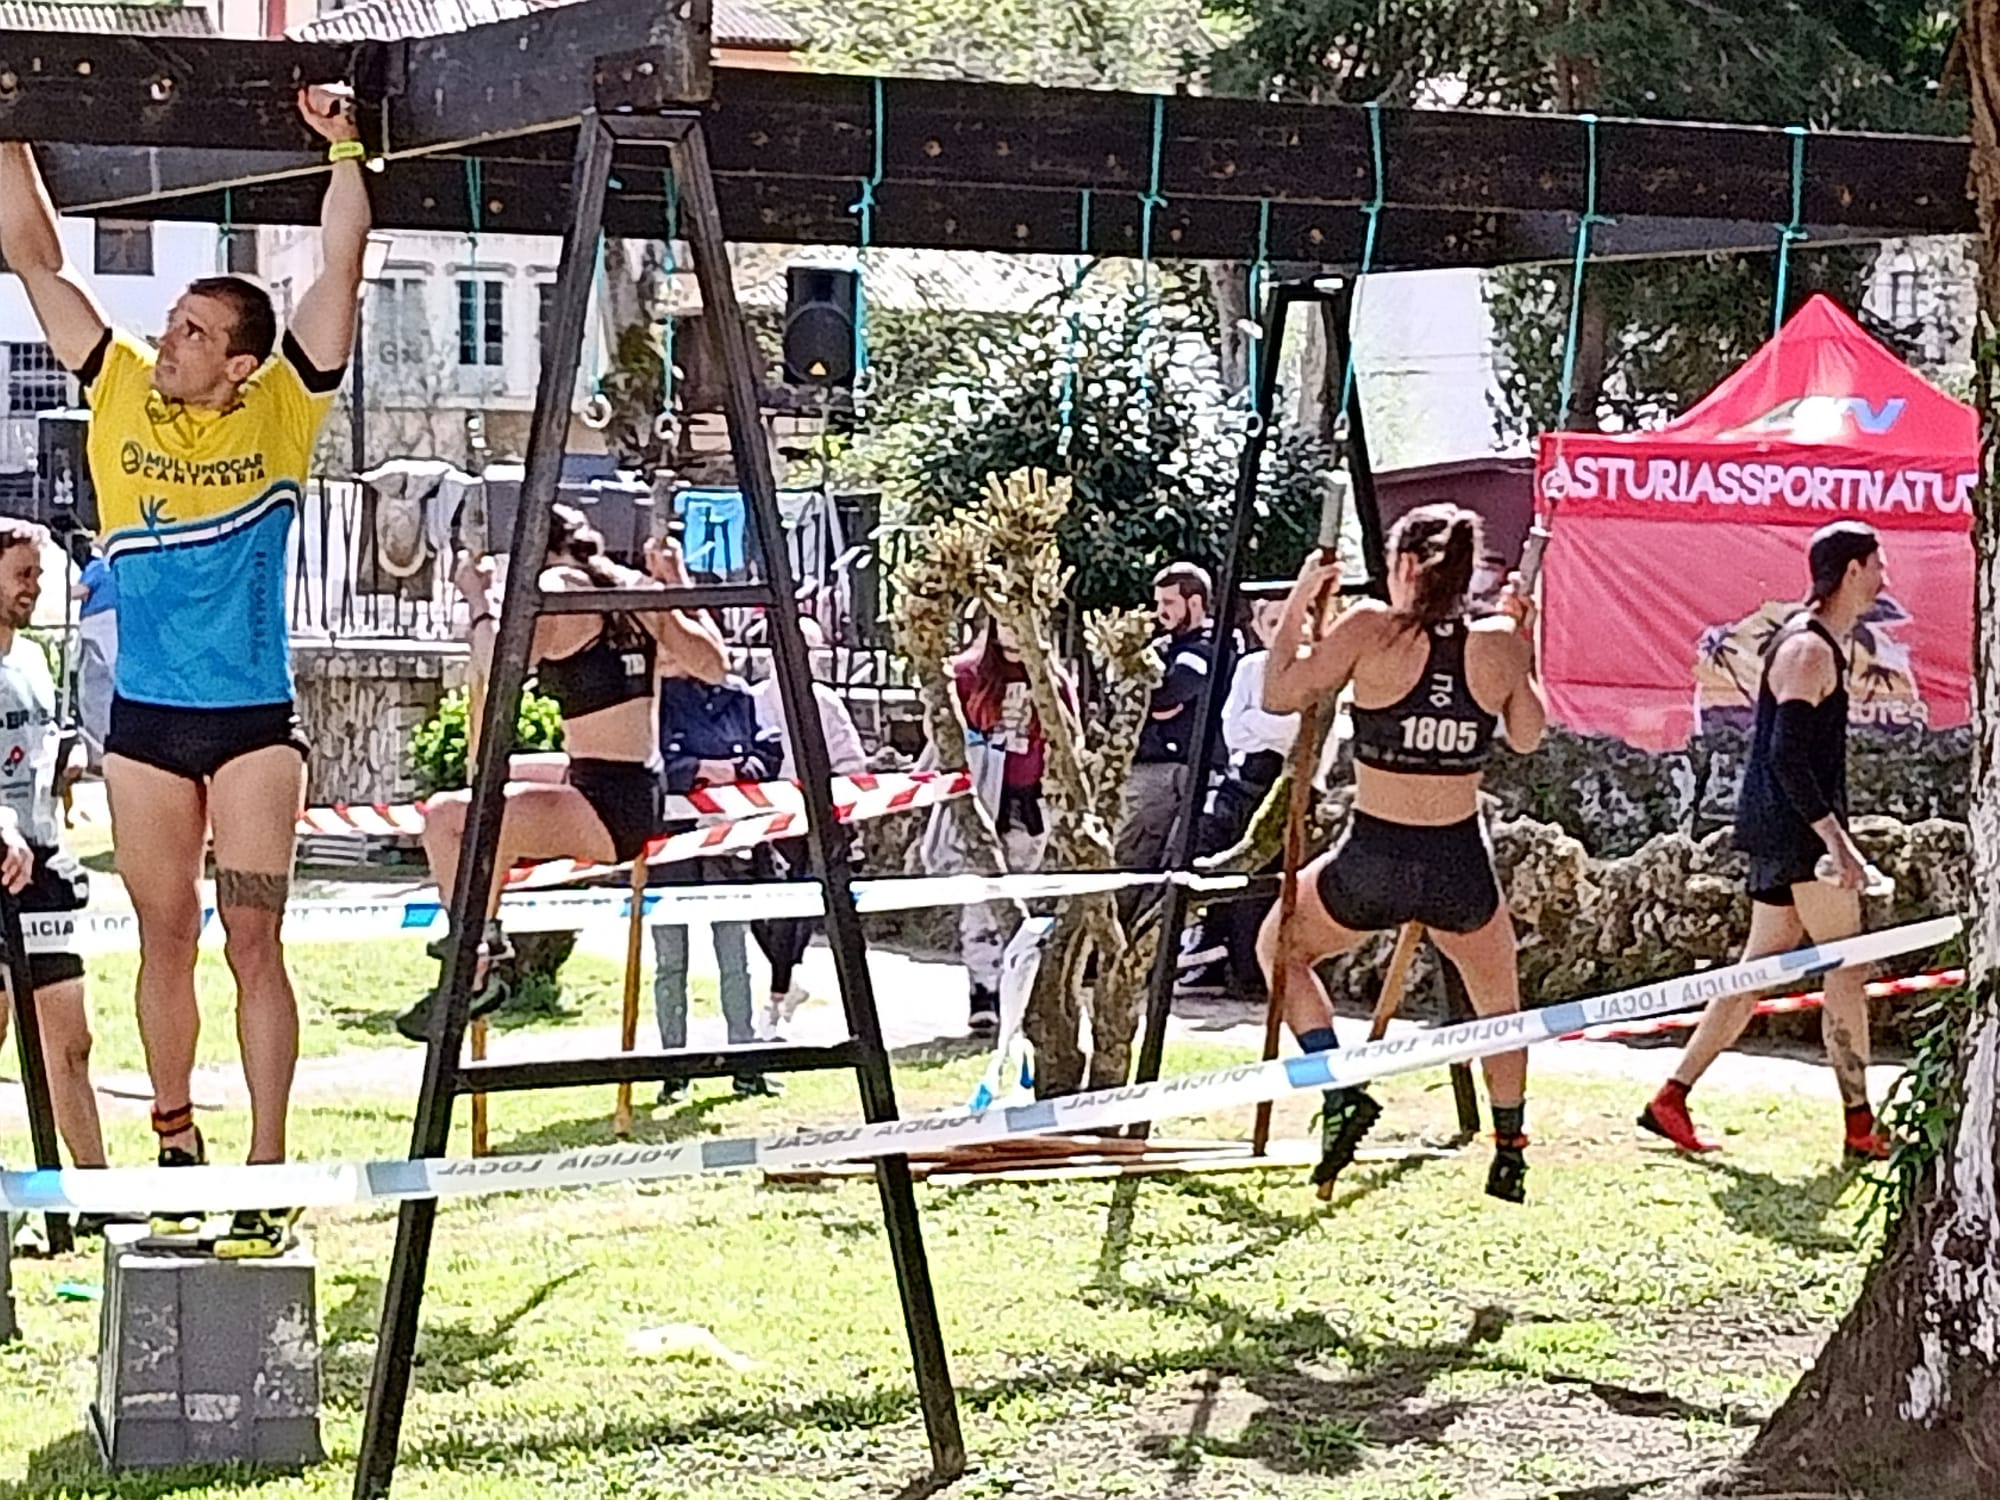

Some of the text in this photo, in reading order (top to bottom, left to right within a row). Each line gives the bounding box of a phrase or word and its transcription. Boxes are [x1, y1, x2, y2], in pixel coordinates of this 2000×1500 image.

[143, 465, 265, 486] CANTABRIA
[1400, 715, 1479, 753] 1805
[24, 919, 75, 937] ICIA
